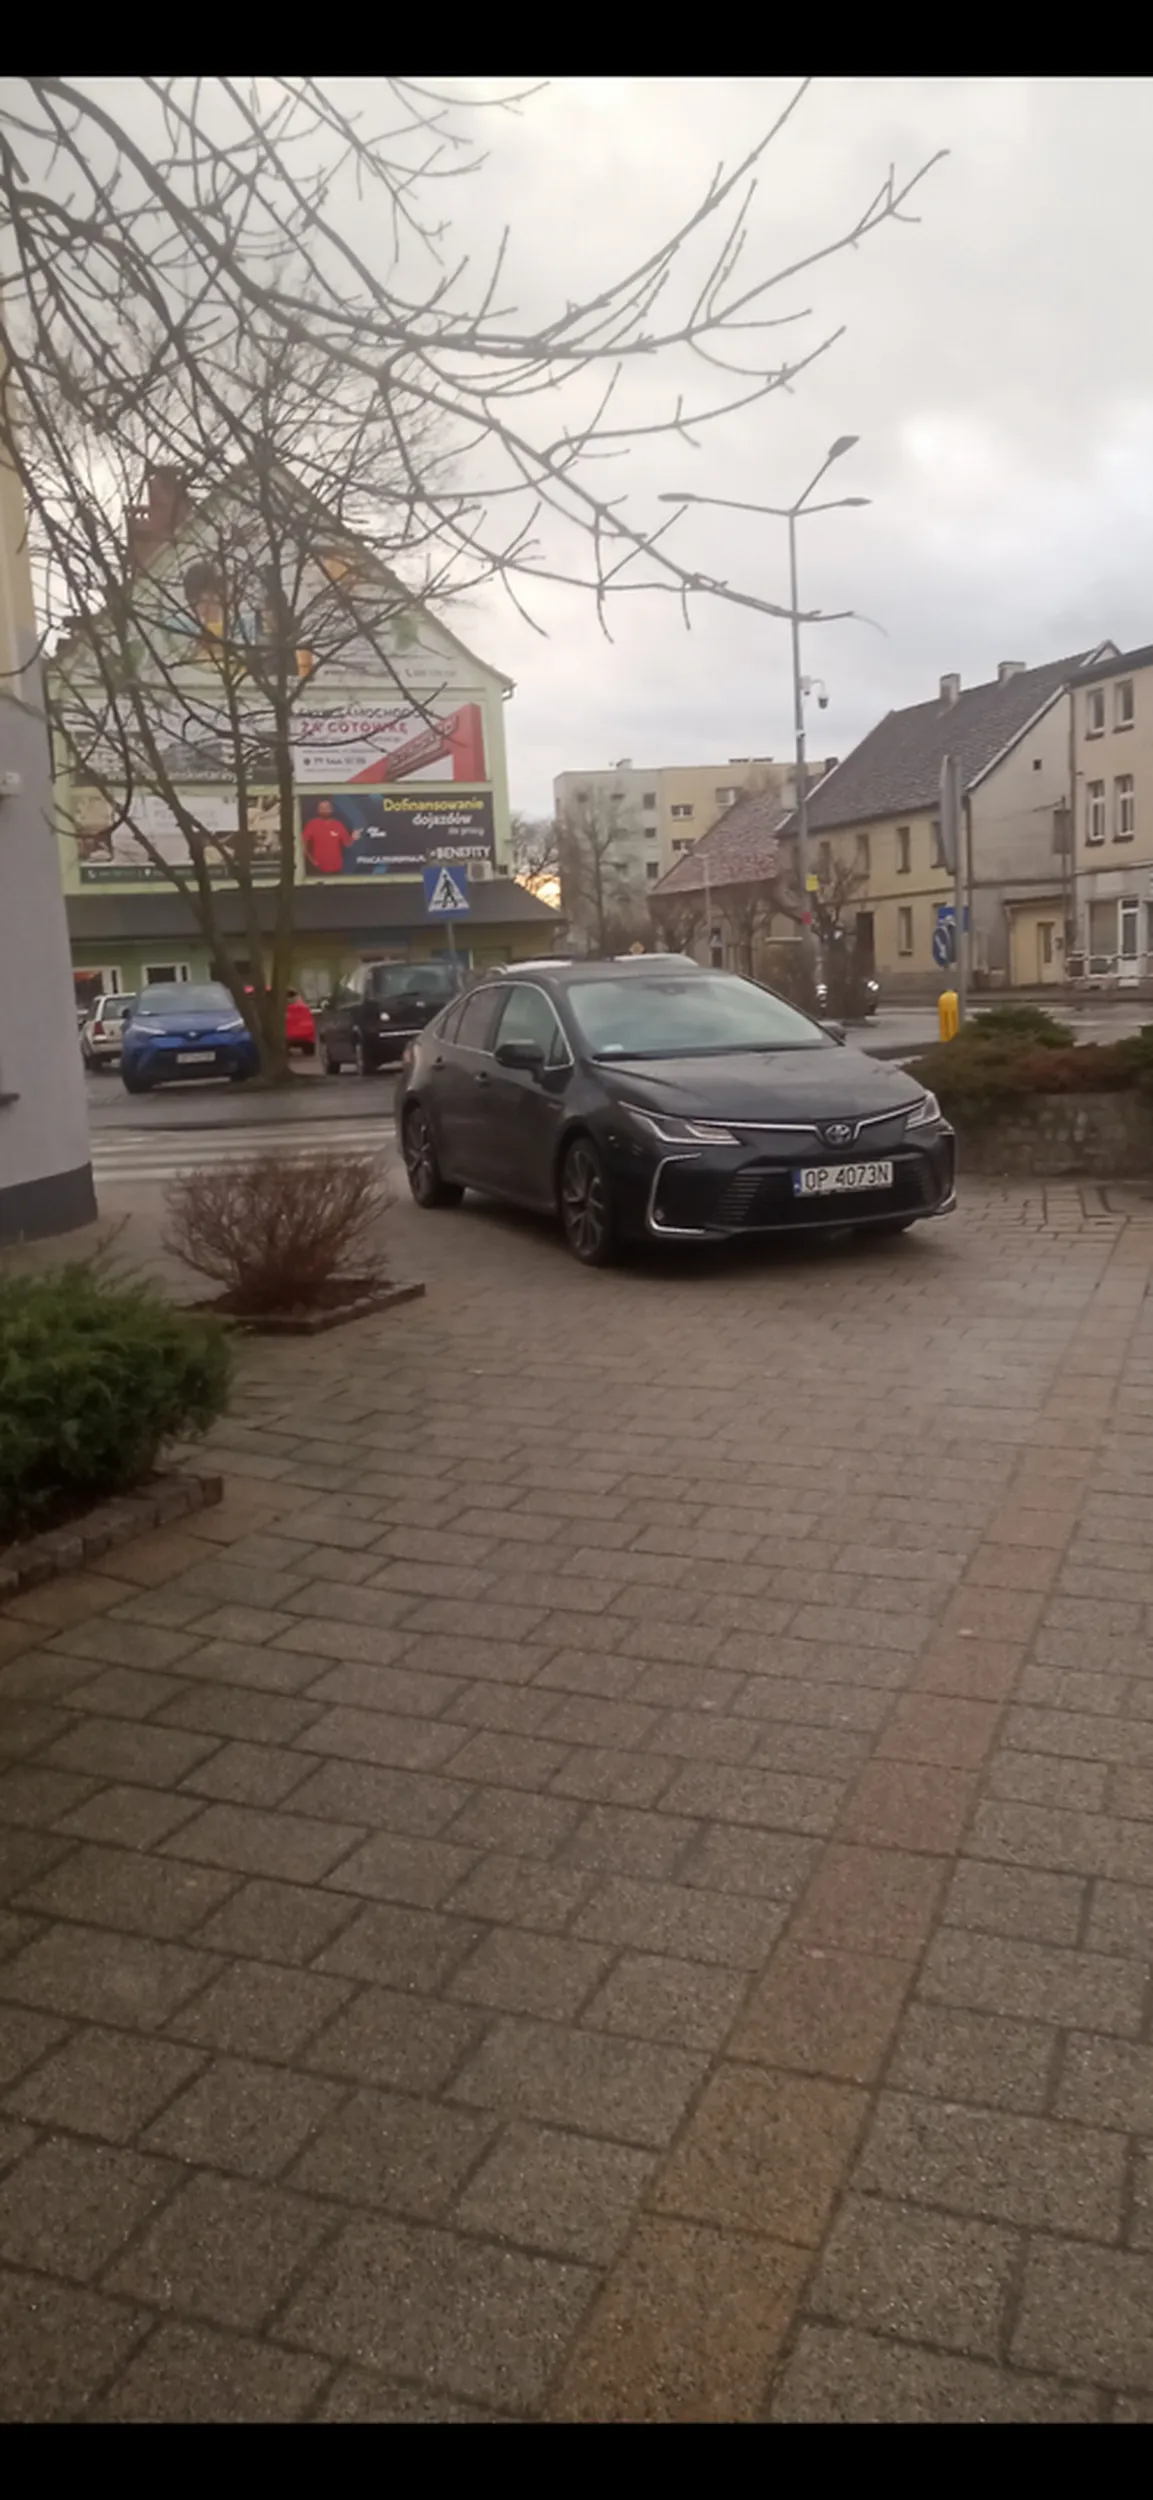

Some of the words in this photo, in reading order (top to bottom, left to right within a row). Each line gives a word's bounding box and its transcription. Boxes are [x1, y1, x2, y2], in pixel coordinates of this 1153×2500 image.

[383, 797, 484, 812] Dofinansowanie
[412, 811, 472, 828] dojazdów
[805, 1169, 829, 1190] OP
[835, 1164, 889, 1186] 4073N
